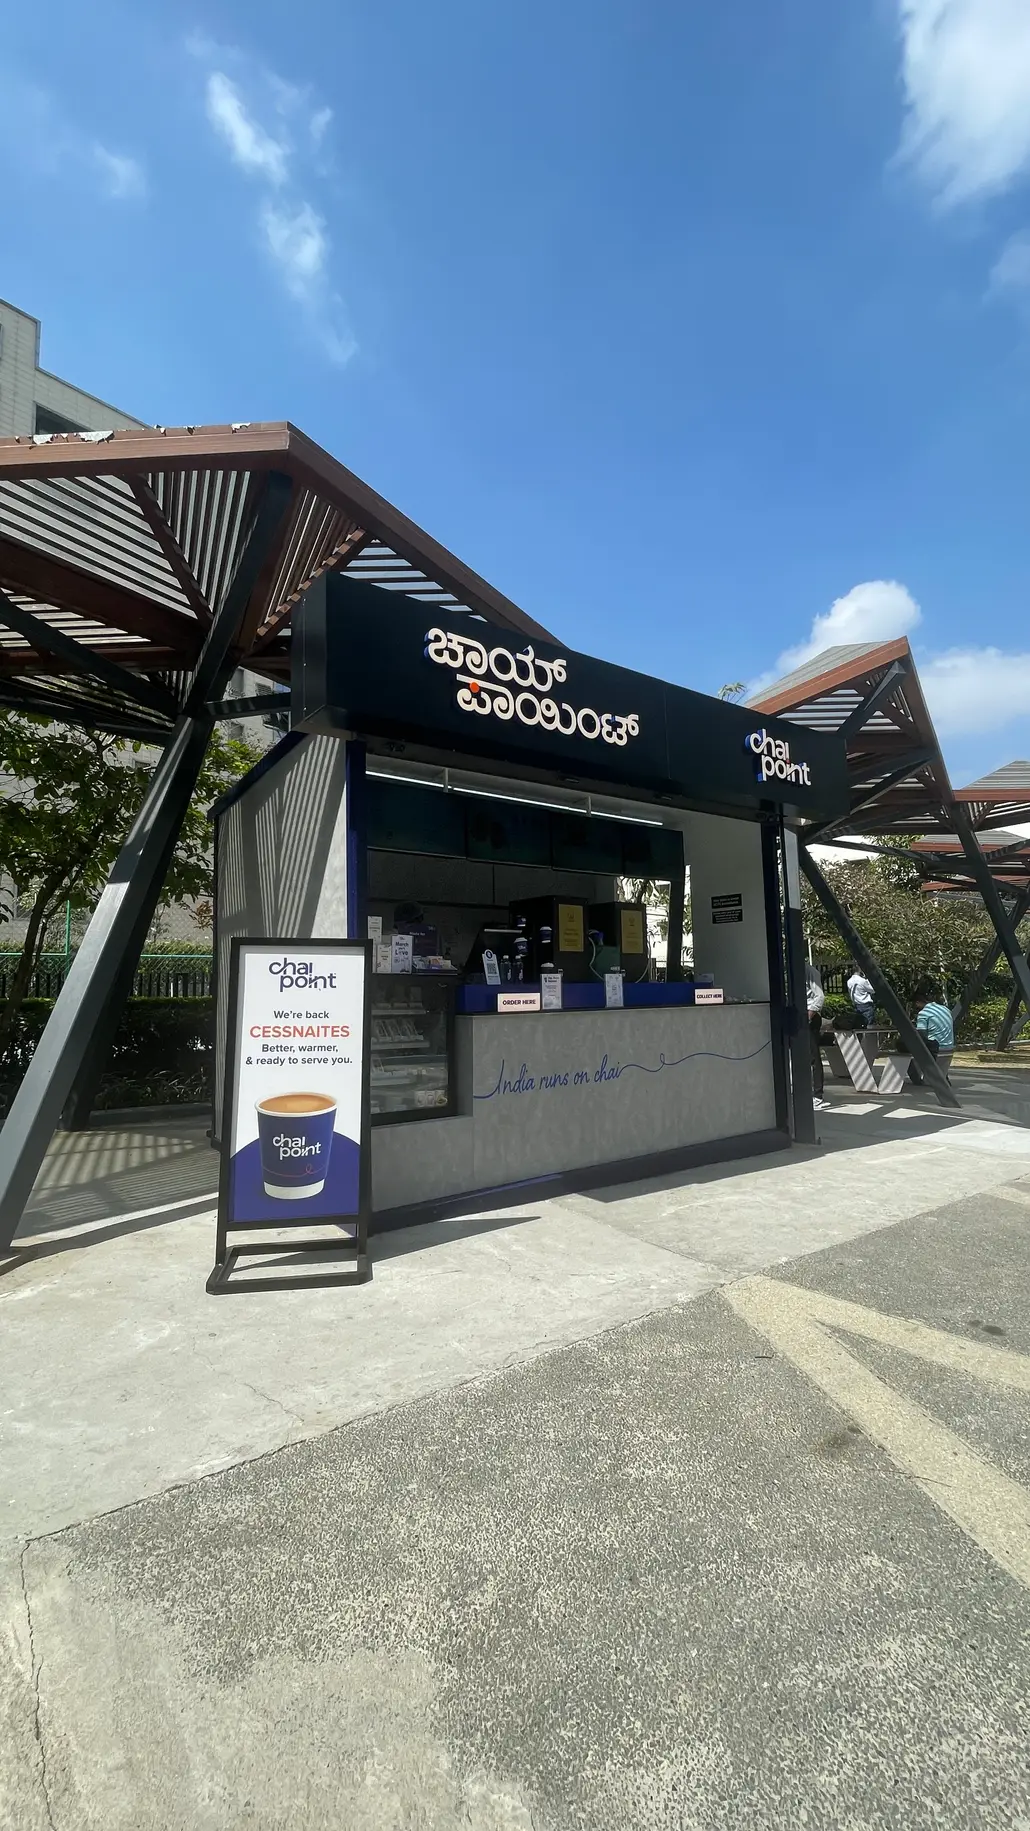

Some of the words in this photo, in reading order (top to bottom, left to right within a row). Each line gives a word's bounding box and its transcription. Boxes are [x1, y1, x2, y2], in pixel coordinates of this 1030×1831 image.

[747, 728, 789, 760] chai
[759, 753, 811, 786] point
[268, 957, 313, 976] chai
[279, 972, 337, 992] point
[273, 1010, 303, 1019] We're
[305, 1010, 330, 1019] back
[249, 1024, 350, 1038] CESSNAITES
[262, 1043, 296, 1054] Better,
[298, 1044, 339, 1054] warmer,
[245, 1056, 254, 1065] &
[256, 1056, 286, 1067] ready
[288, 1057, 299, 1065] to
[301, 1057, 329, 1065] serve
[330, 1056, 353, 1066] you.
[494, 1059, 536, 1095] India
[539, 1072, 570, 1091] runs
[573, 1070, 590, 1085] on
[594, 1054, 622, 1081] chai
[272, 1133, 306, 1148] chai
[279, 1142, 321, 1160] point
